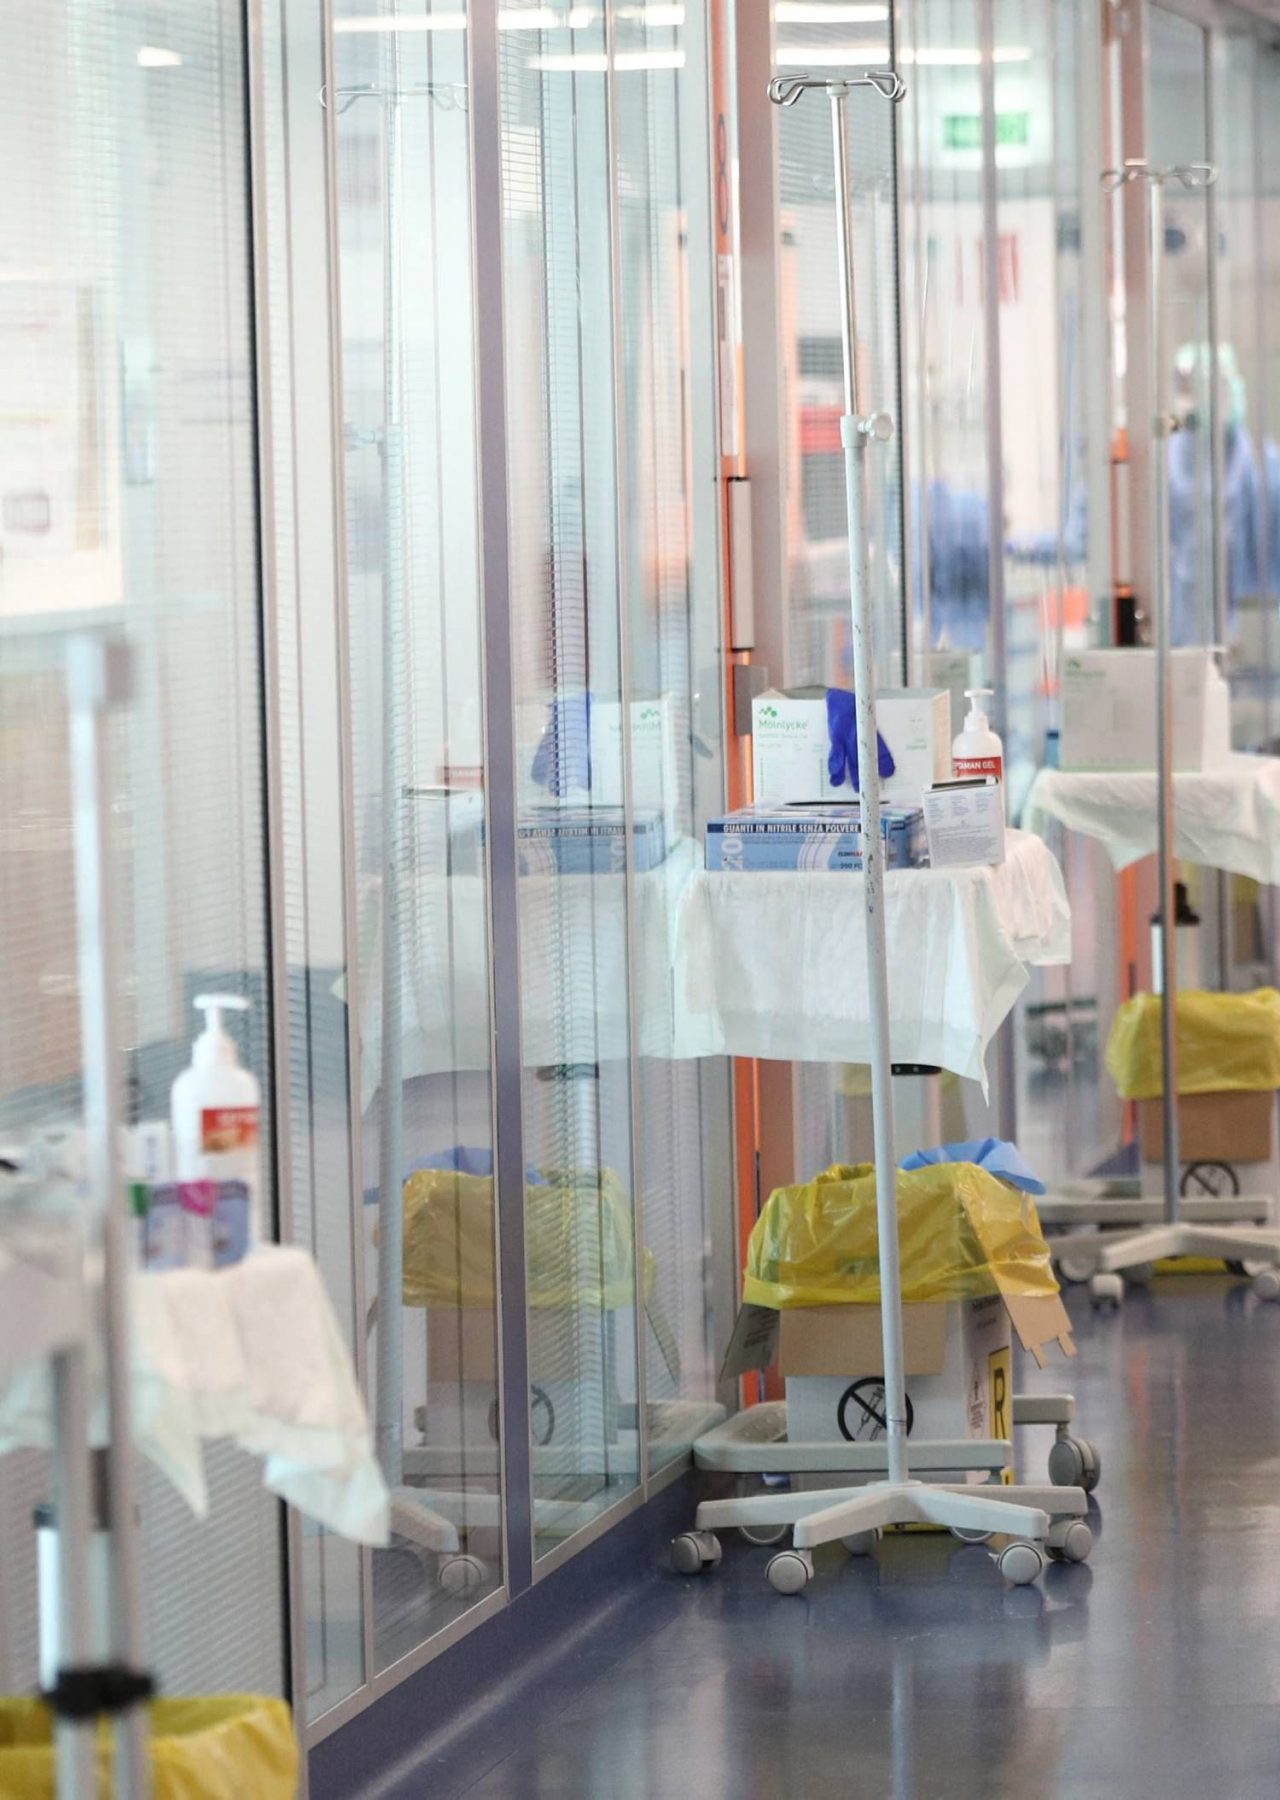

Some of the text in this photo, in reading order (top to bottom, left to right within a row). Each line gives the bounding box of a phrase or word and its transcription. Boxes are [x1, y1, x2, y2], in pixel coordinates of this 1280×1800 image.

[723, 824, 858, 833] GUANTI IN NITRILE SENZA POLVERE
